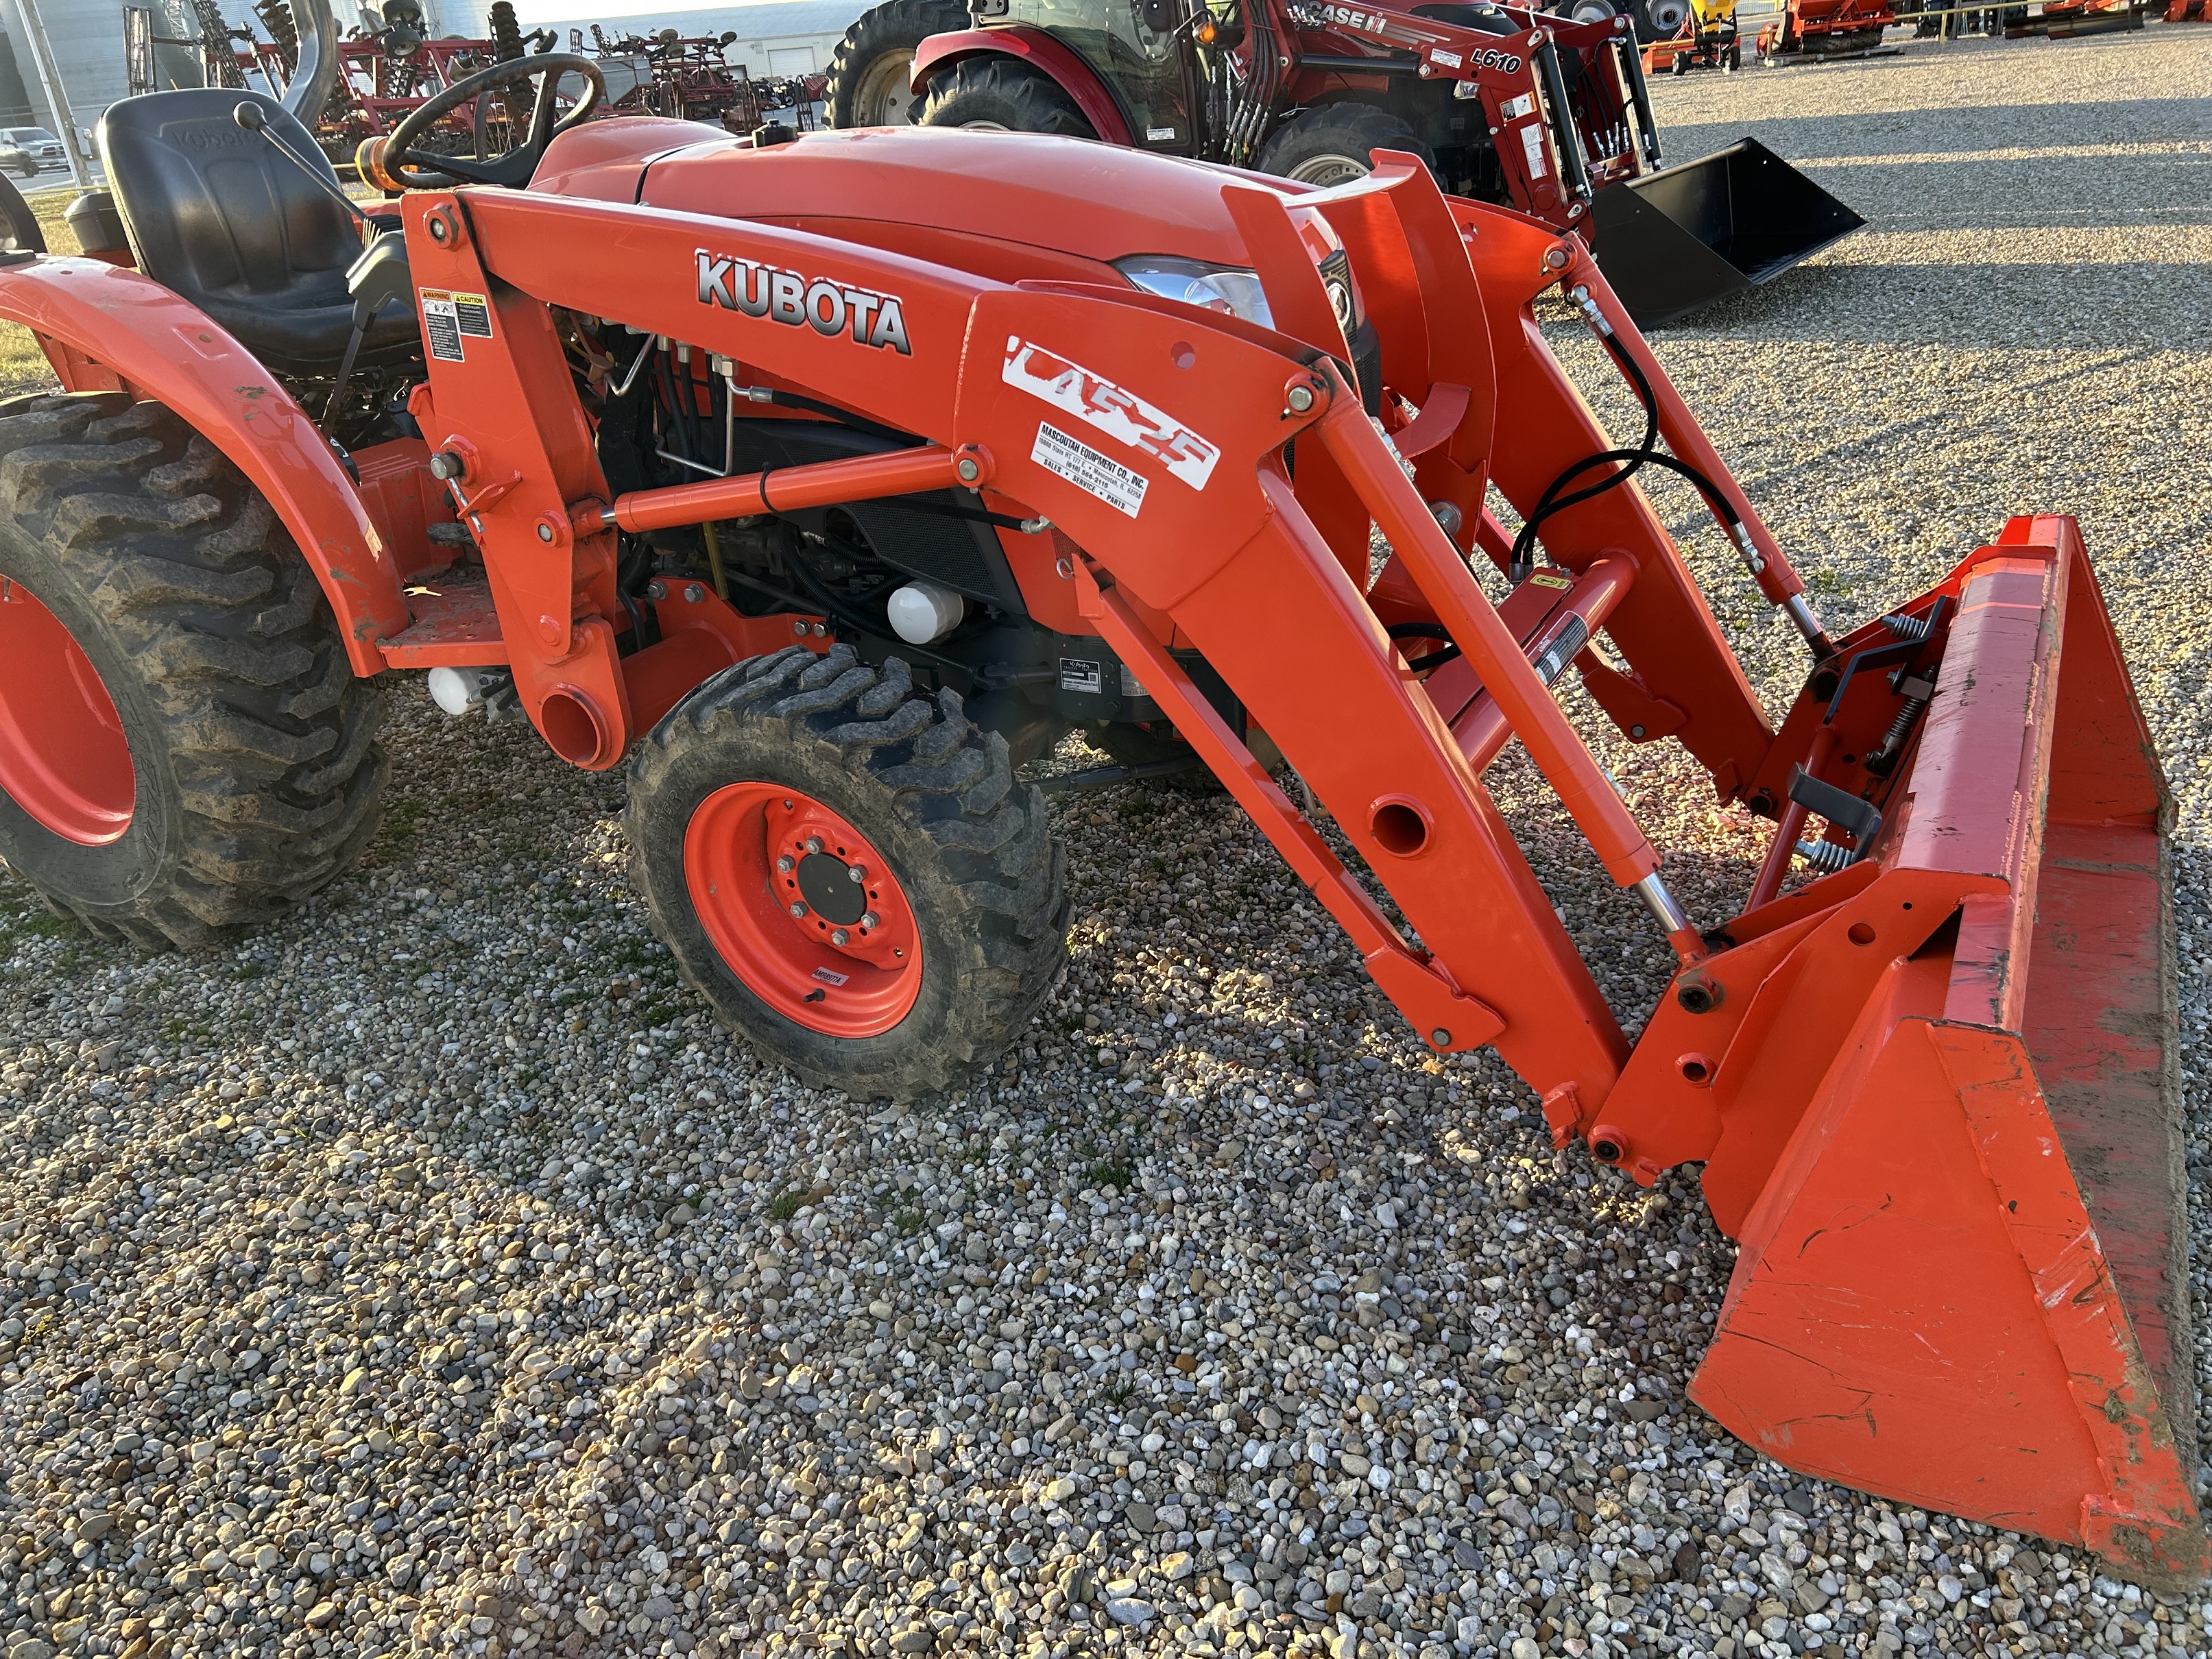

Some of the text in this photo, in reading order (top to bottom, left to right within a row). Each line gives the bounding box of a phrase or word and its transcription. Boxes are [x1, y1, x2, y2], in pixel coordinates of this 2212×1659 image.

[1309, 1, 1365, 28] CASE
[1470, 48, 1522, 74] L610
[426, 292, 450, 300] WARNING
[697, 252, 911, 356] KUBOTA
[1041, 424, 1144, 489] MASCOUTAH EQUIPMENT CO., INC.
[1052, 443, 1063, 455] State
[1093, 467, 1118, 488] Mascoutah,
[1044, 459, 1126, 509] SALES SERVICE PARTS
